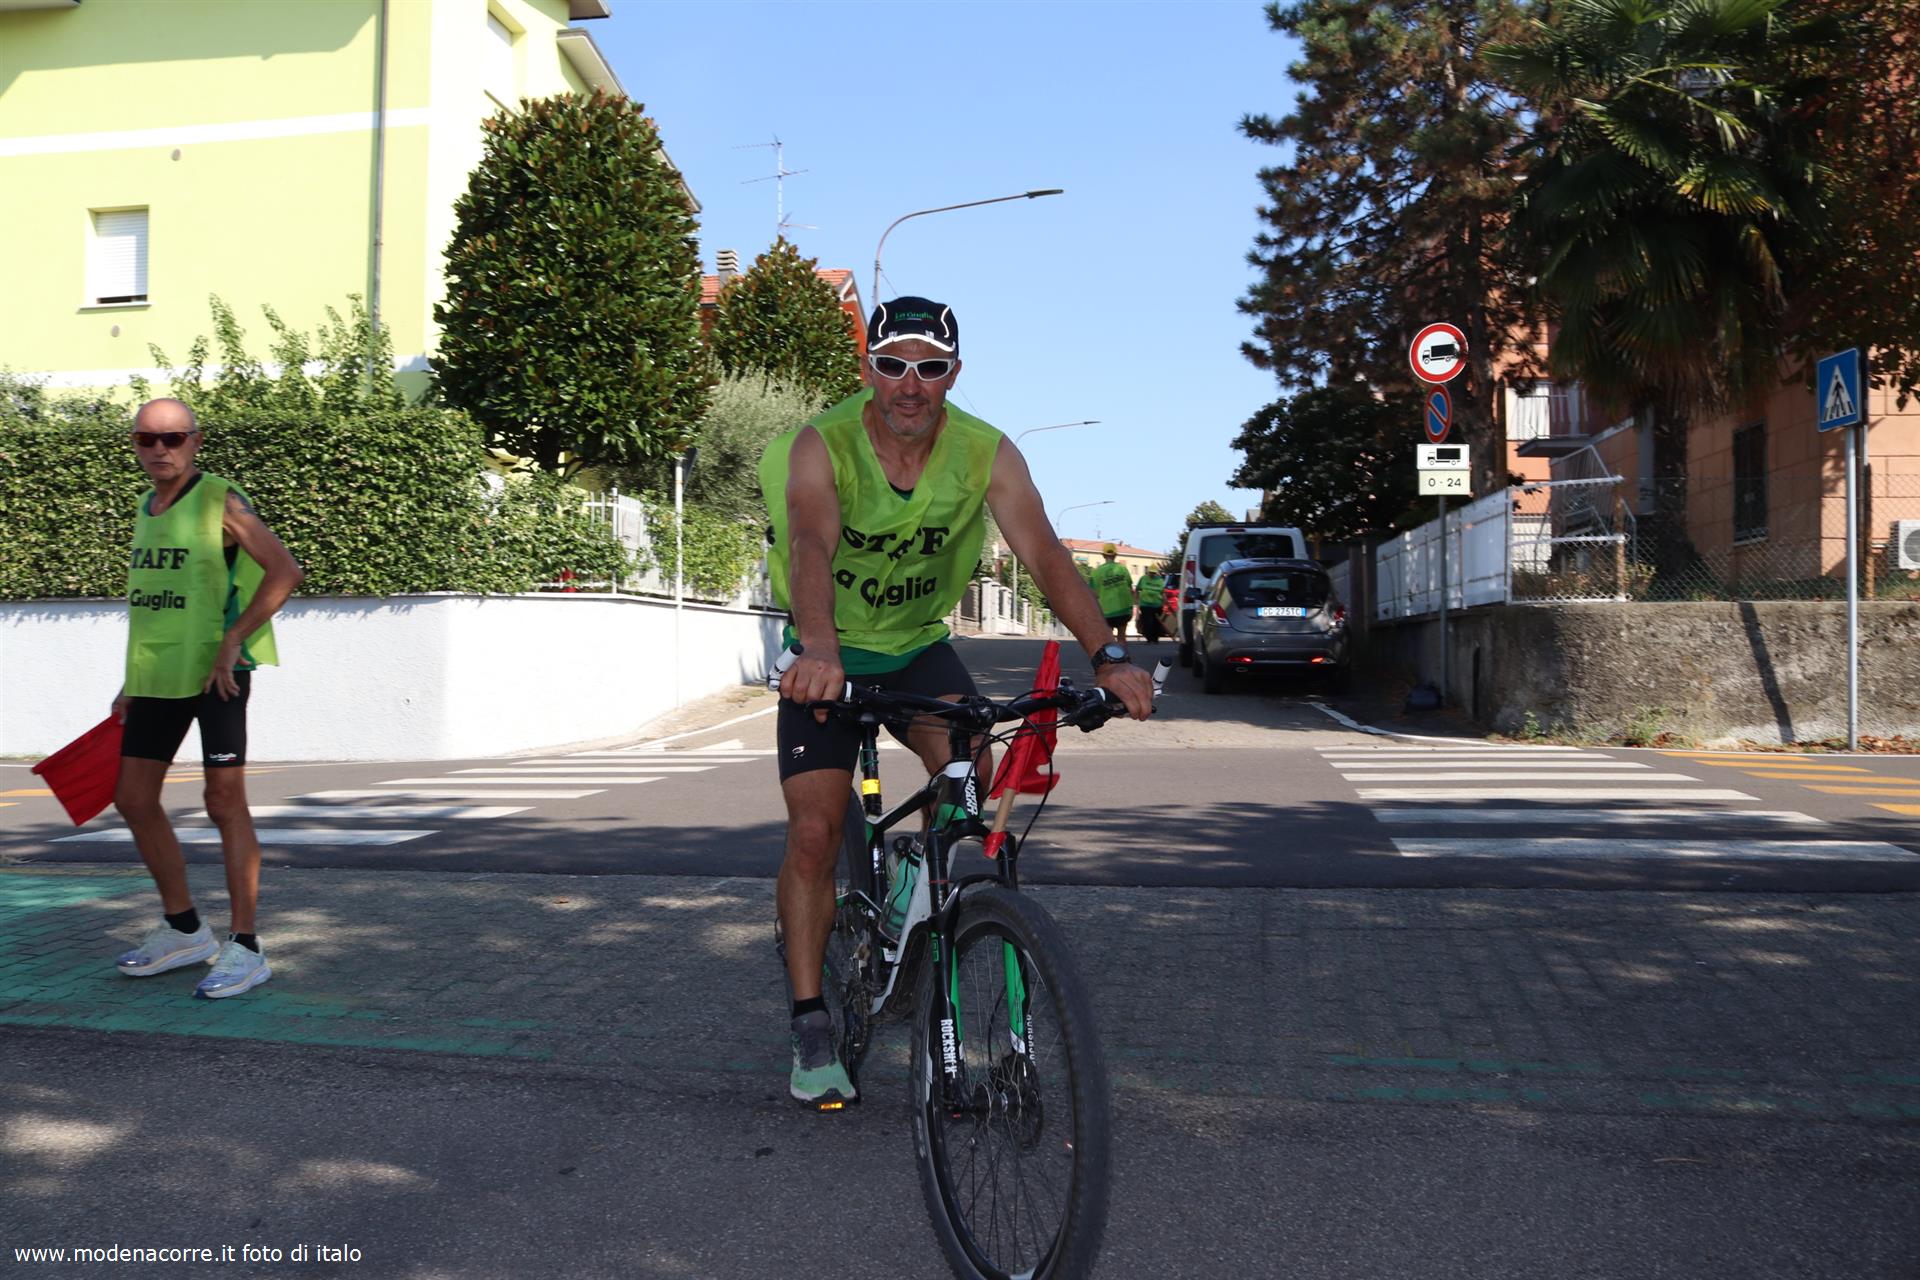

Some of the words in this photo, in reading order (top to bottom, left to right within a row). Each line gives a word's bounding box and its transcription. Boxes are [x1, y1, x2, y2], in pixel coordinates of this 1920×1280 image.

[1428, 477, 1436, 487] 0
[1447, 477, 1461, 487] 24
[842, 525, 950, 561] STAF
[833, 569, 857, 590] a
[130, 589, 186, 611] Guglia
